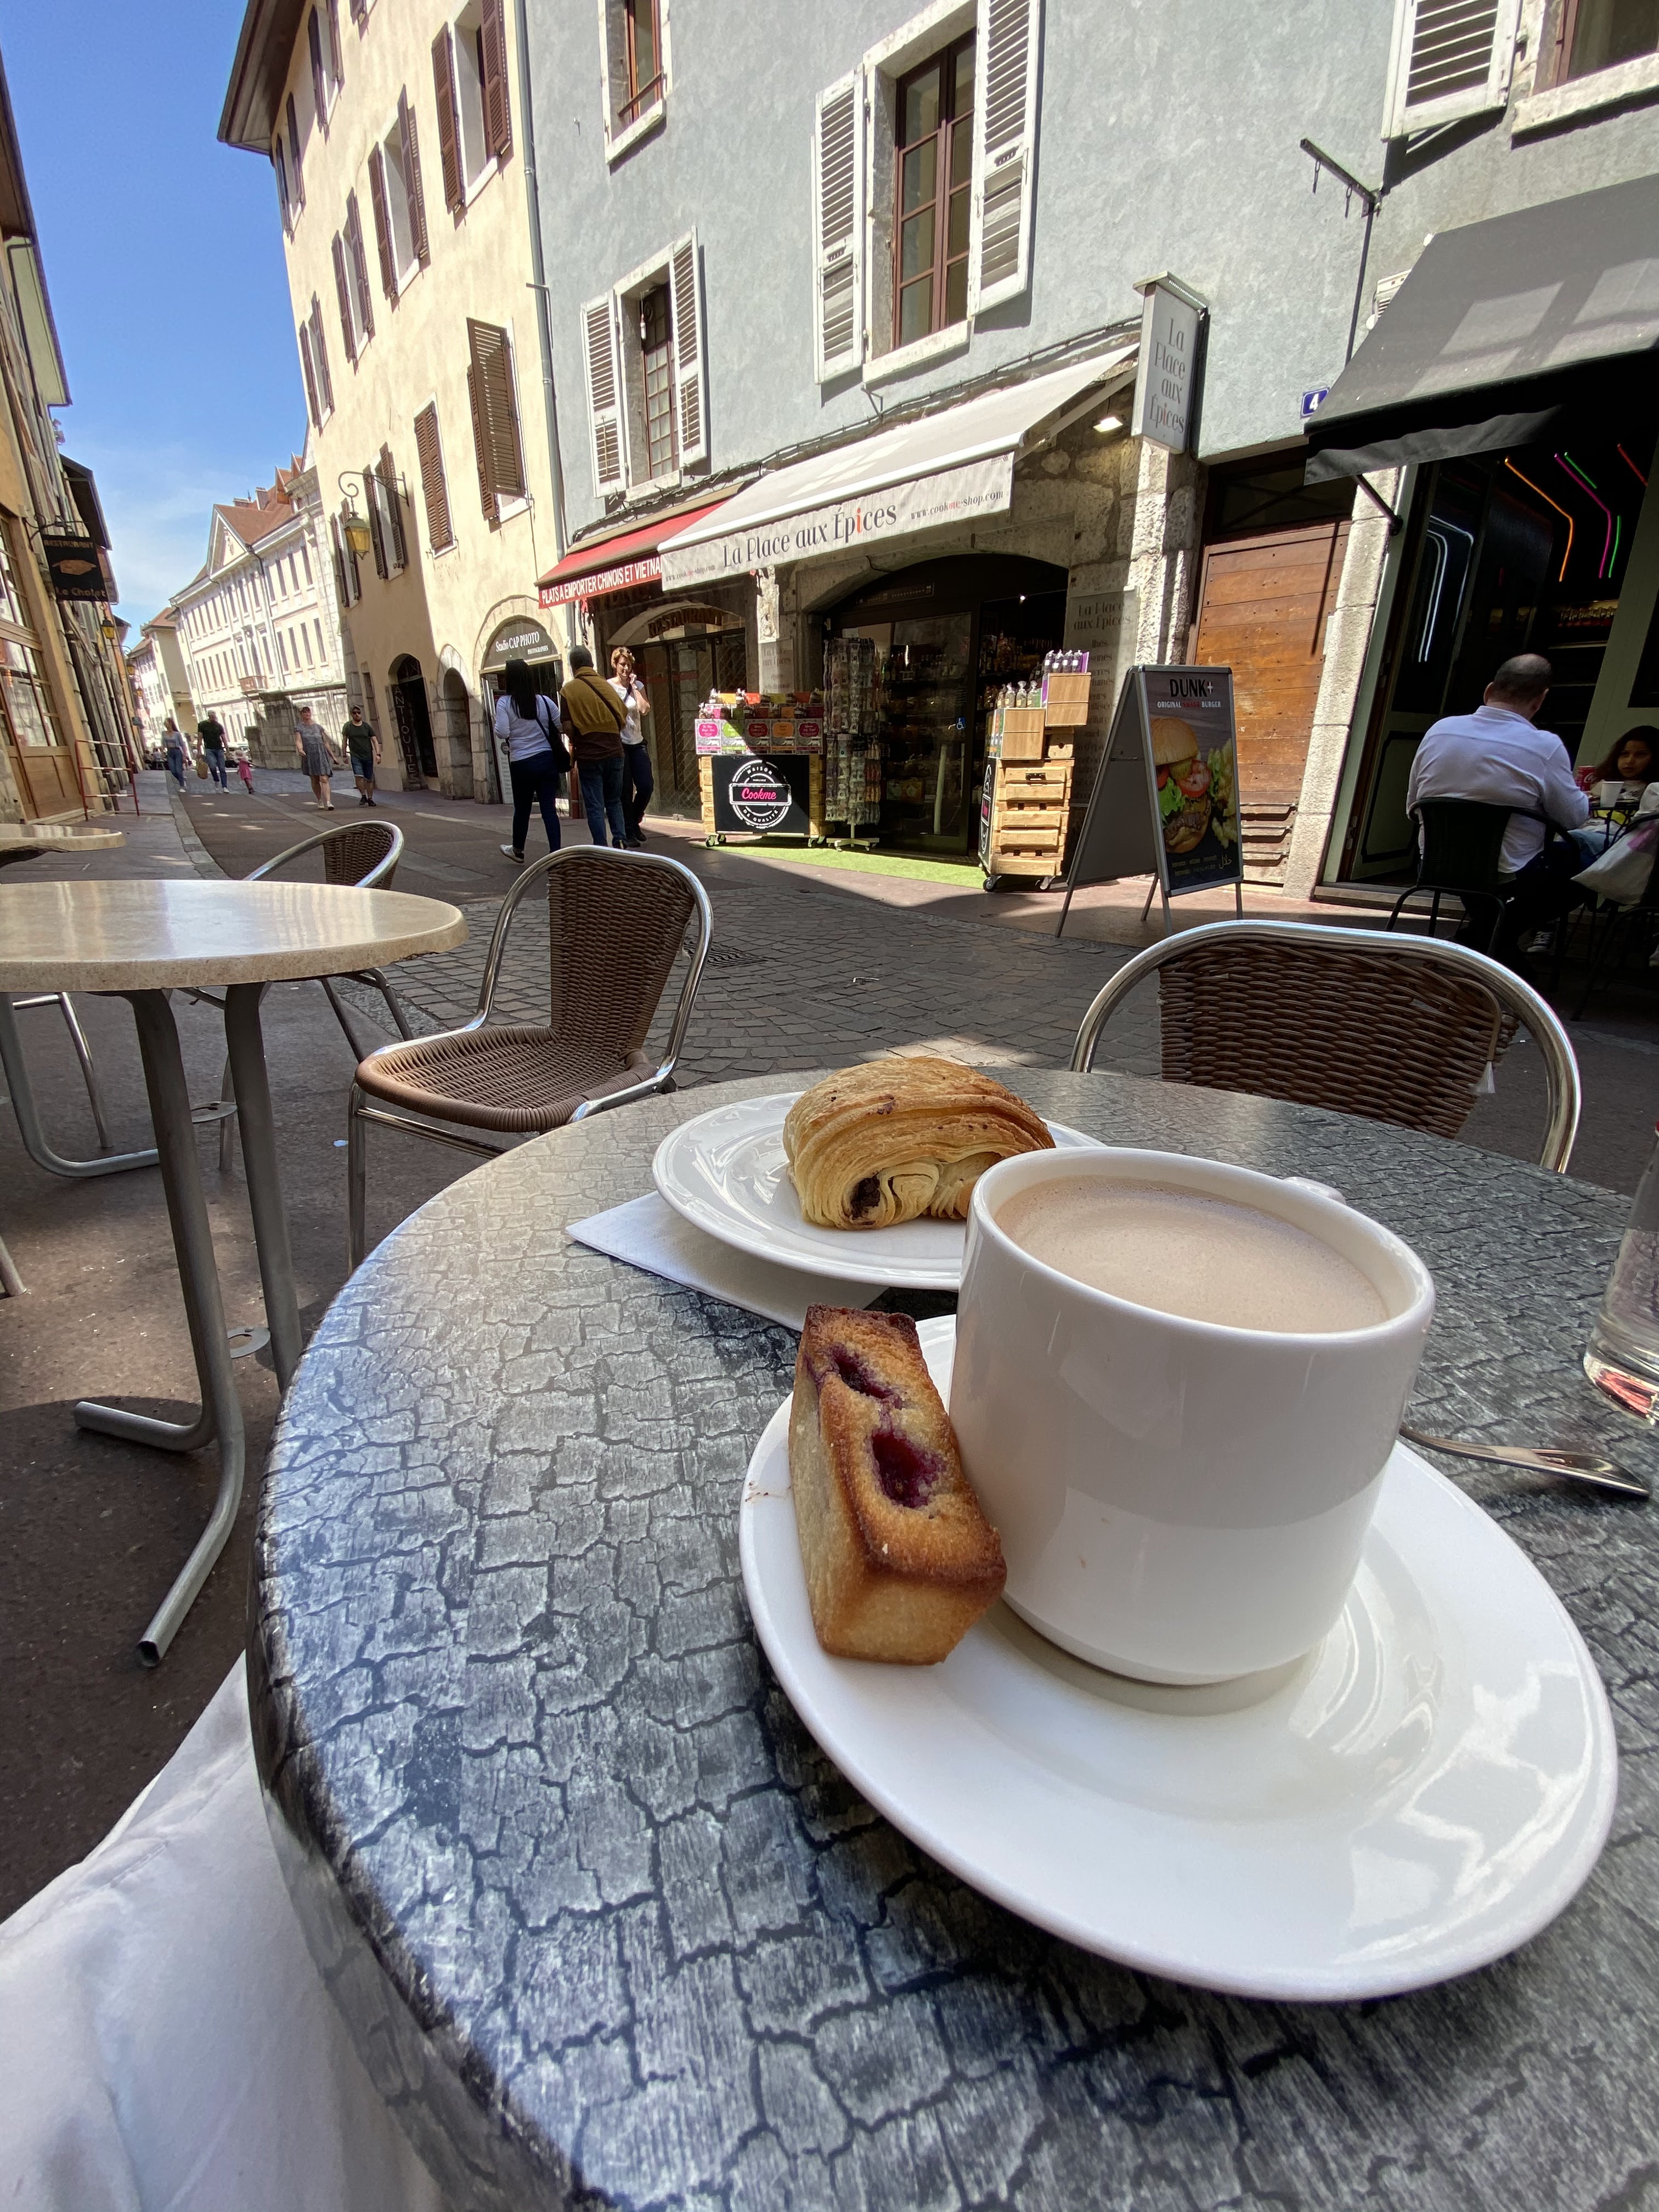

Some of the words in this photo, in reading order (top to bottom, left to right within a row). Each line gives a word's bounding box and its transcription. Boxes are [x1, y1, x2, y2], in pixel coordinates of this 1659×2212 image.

[1167, 317, 1184, 352] La
[1154, 340, 1186, 380] Place
[1161, 378, 1182, 404] aux
[1309, 393, 1319, 410] 4
[1149, 393, 1184, 433] Épices
[911, 491, 1003, 520] www.cookme-shop.com
[723, 544, 743, 568] La
[746, 534, 790, 562] Place
[796, 523, 827, 548] aux
[833, 505, 897, 543] Épices
[541, 586, 560, 605] PLATS
[560, 585, 565, 601] A
[564, 577, 597, 600] EMPORTER
[597, 567, 624, 591] CHINOIS
[624, 565, 634, 583] ET
[1074, 620, 1093, 630] aux
[495, 640, 509, 652] Studio
[509, 636, 520, 648] CAP
[520, 631, 540, 647] PHOTO
[394, 686, 419, 783] ANTIQUITES
[747, 766, 772, 775] MAISON
[741, 787, 777, 800] Cookme
[743, 809, 751, 817] DE
[1218, 854, 1232, 870] حلال
